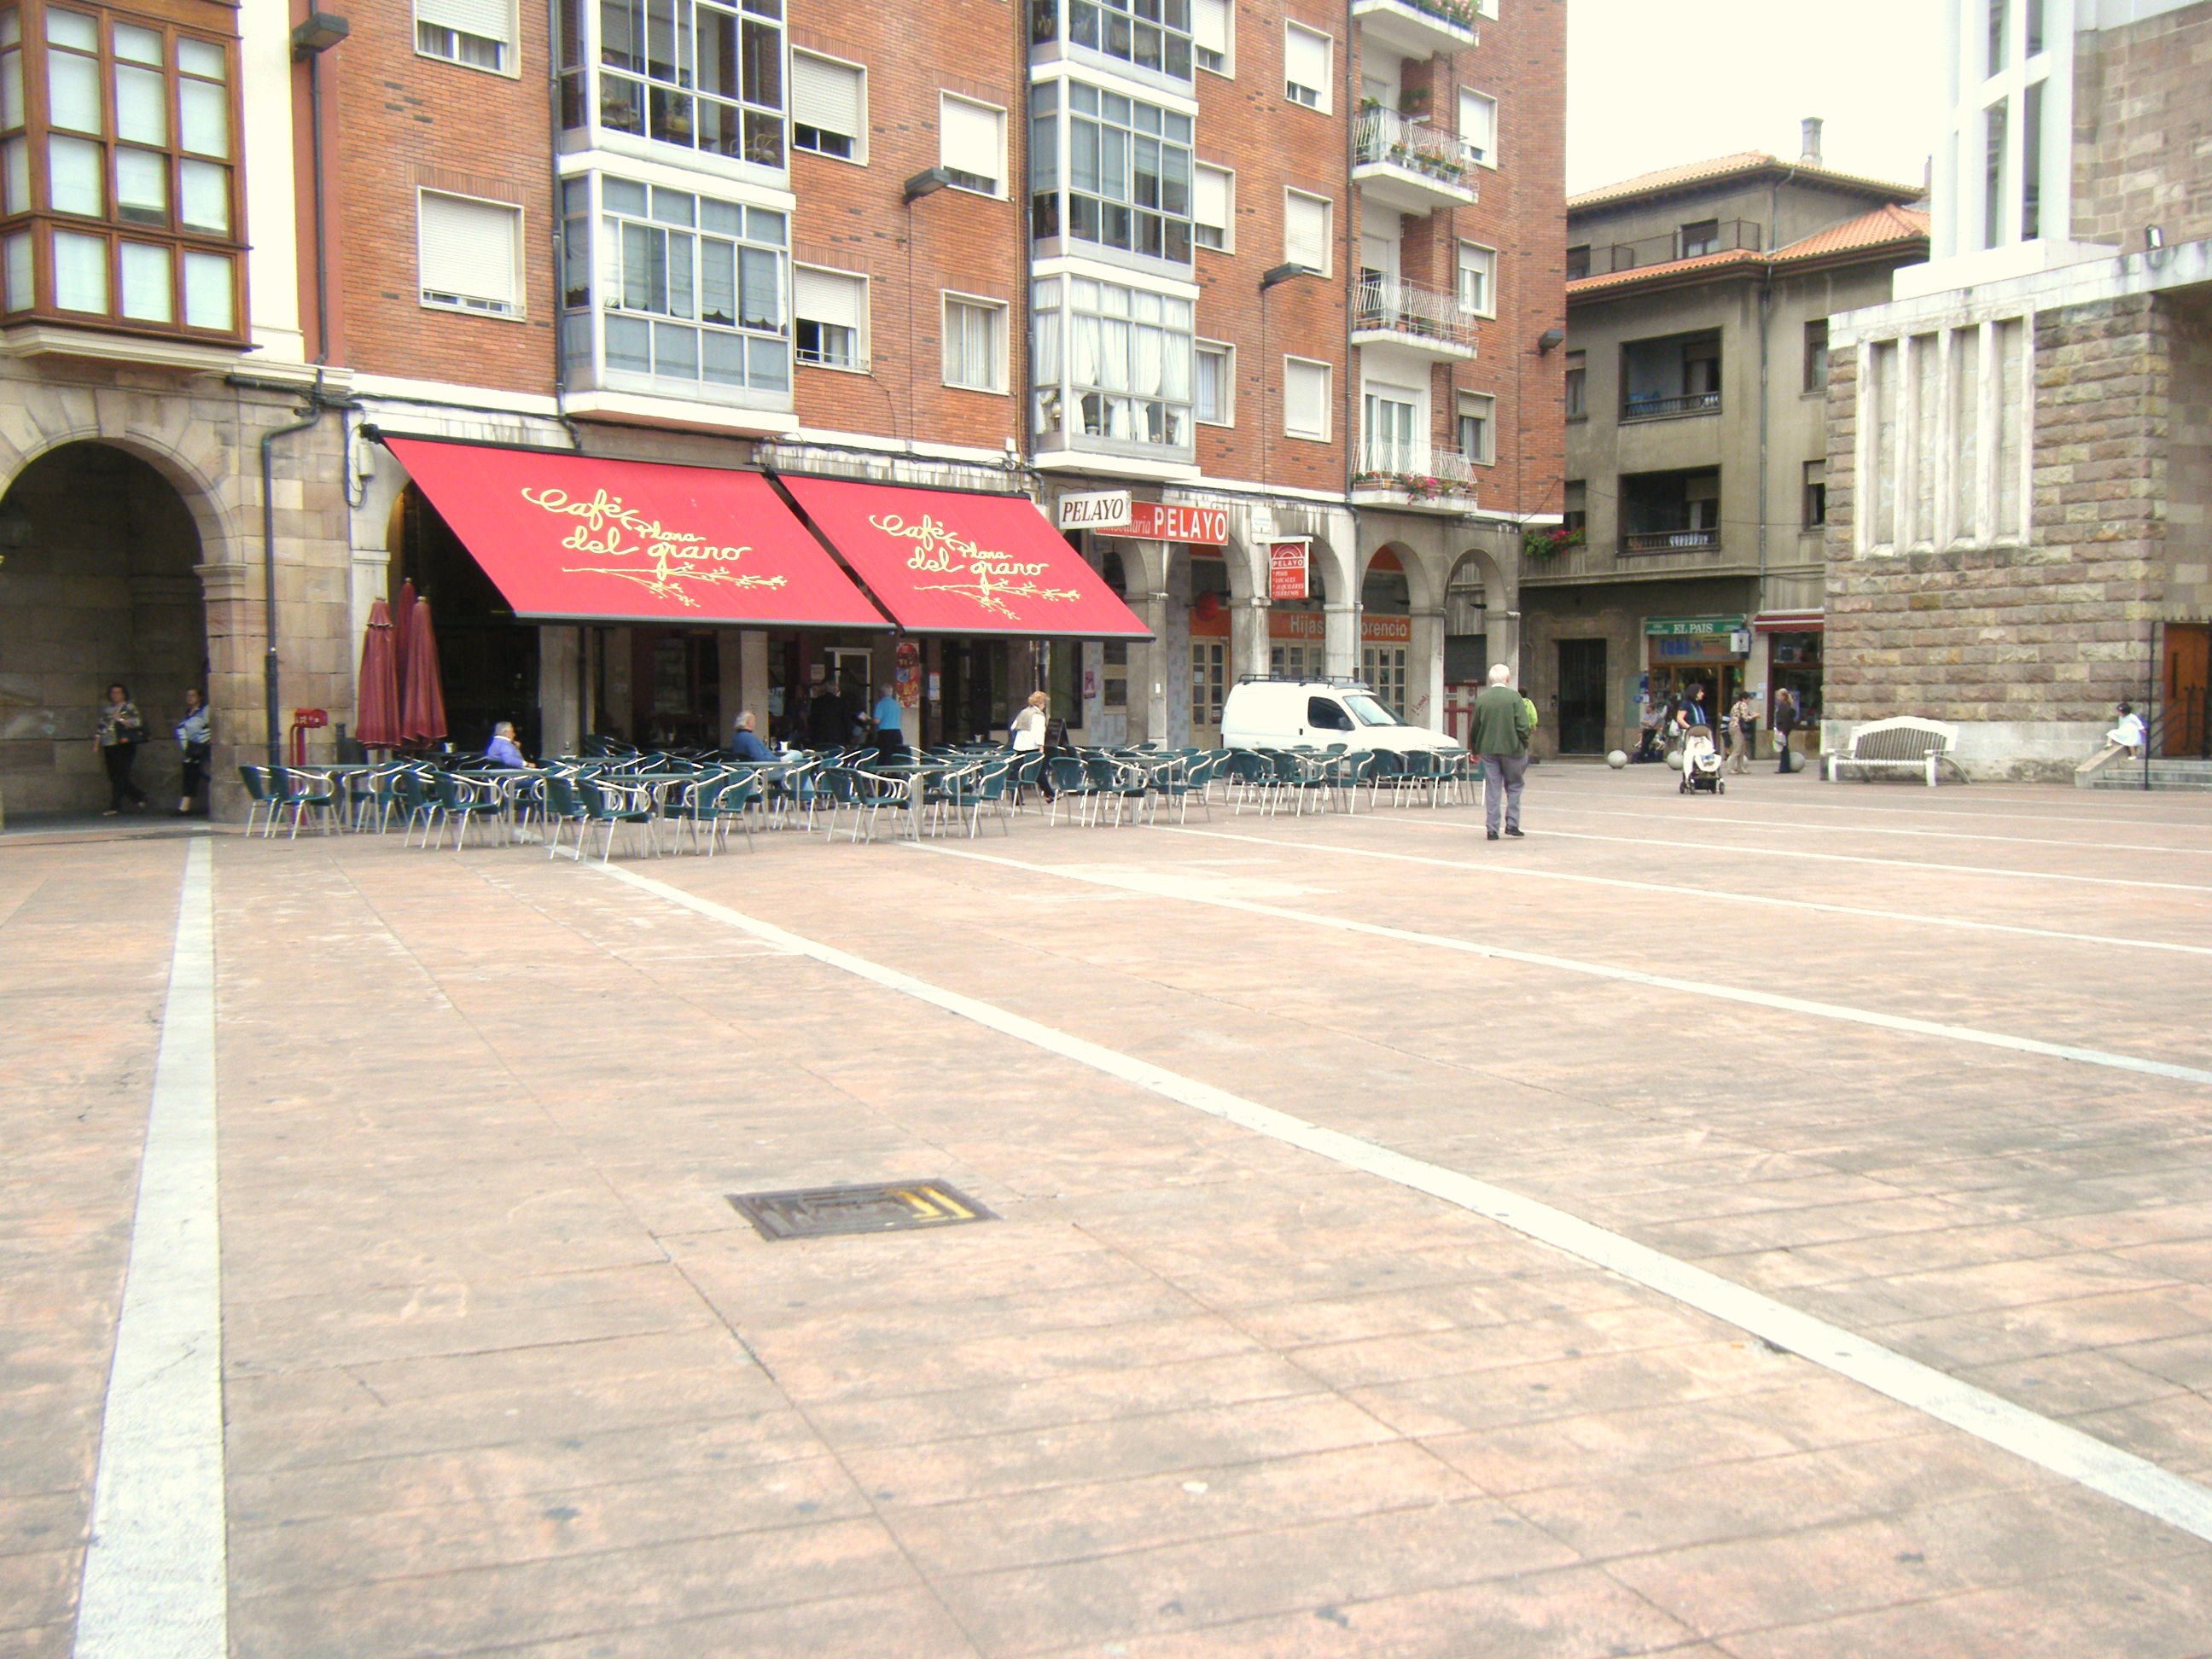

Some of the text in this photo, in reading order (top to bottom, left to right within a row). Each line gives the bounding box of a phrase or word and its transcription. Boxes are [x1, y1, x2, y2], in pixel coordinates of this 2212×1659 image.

[1062, 498, 1123, 522] PELAYO
[1154, 507, 1226, 541] PELAYO
[562, 526, 752, 581] del grano
[906, 547, 1049, 596] del grano
[1290, 614, 1407, 638] Hijas orencio
[1674, 624, 1688, 634] EL
